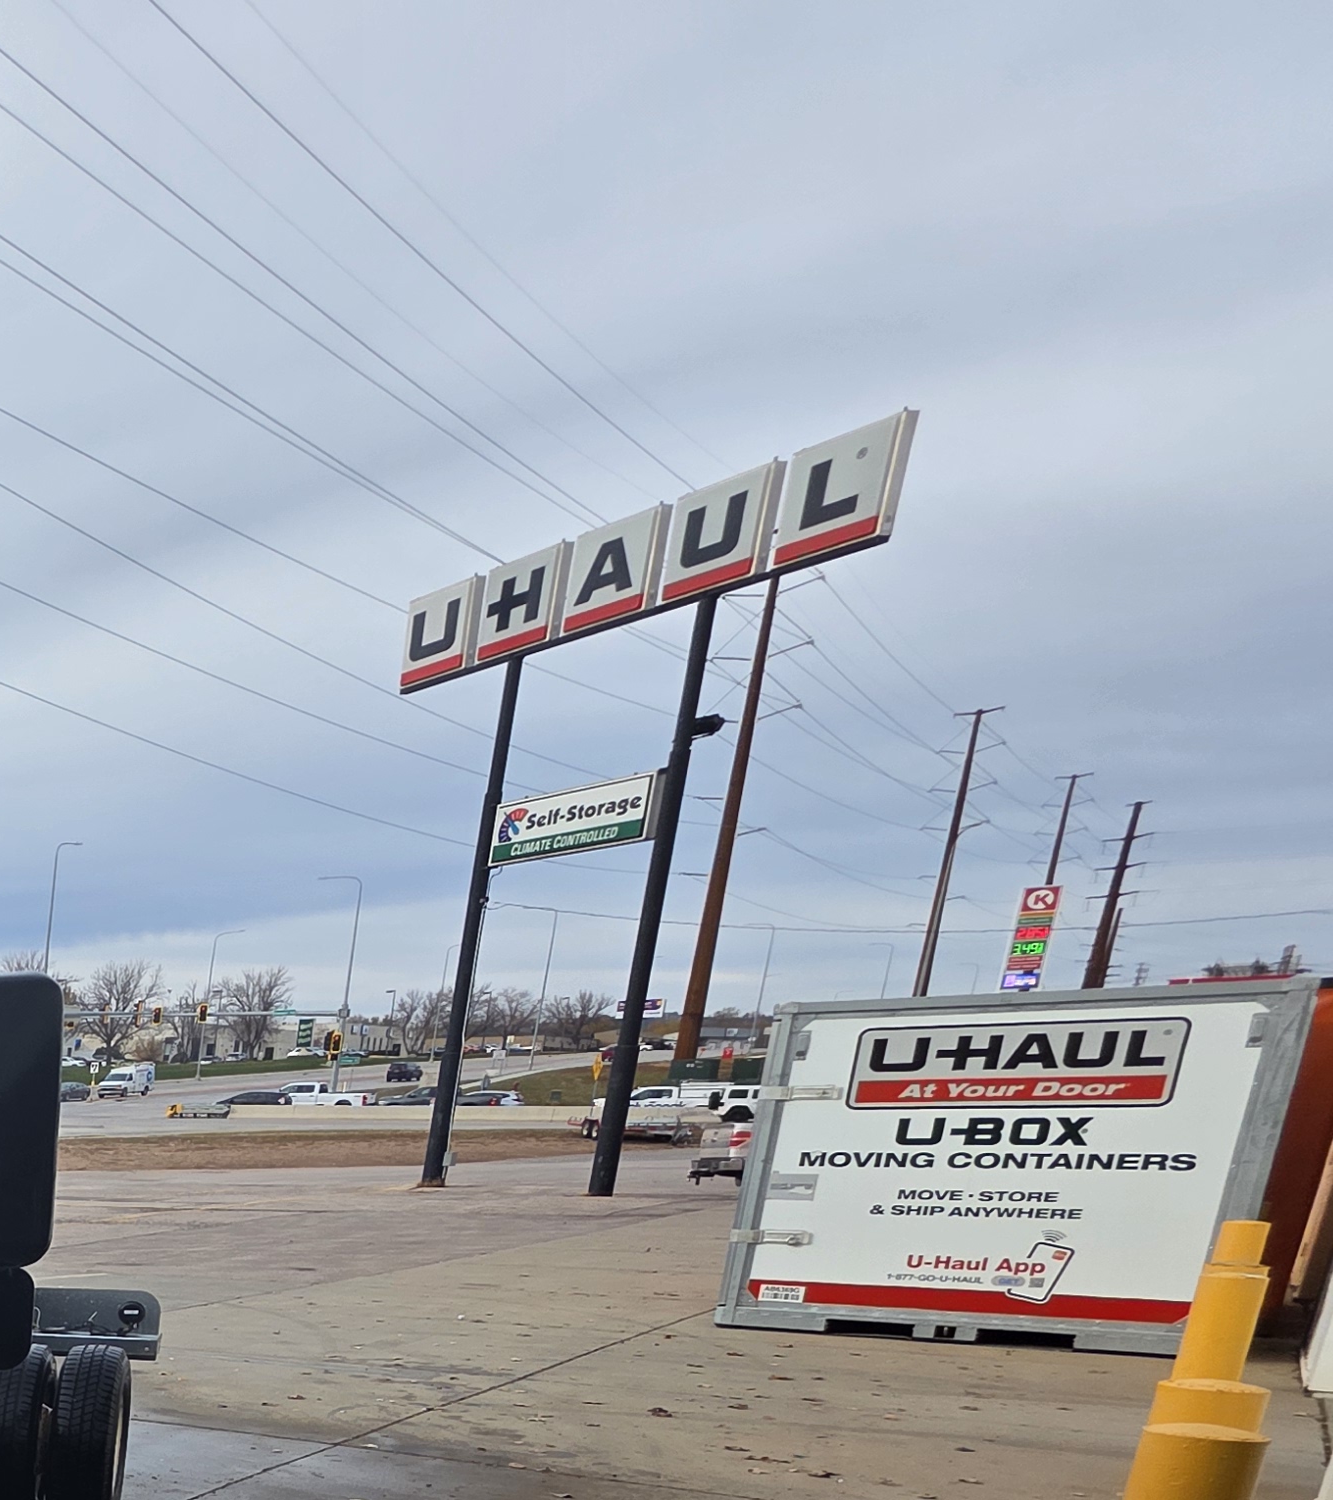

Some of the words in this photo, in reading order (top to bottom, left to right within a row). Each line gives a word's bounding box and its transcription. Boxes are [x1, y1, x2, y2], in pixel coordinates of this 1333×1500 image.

[525, 795, 643, 831] Self-Storage
[510, 839, 551, 857] CLIMATE
[553, 826, 619, 849] CONTROLLED
[868, 1029, 1166, 1072] U-HAUL
[897, 1083, 937, 1098] At
[947, 1083, 1025, 1098] Your
[1031, 1081, 1126, 1097] Door
[894, 1117, 1094, 1146] U-BOX
[798, 1151, 935, 1170] MOVING
[946, 1153, 1197, 1172] CONTAINERS
[897, 1188, 964, 1201] MOVE
[978, 1190, 1059, 1203] STORE
[869, 1204, 885, 1216] &
[890, 1204, 945, 1216] SHIP
[947, 1206, 1083, 1220] ANYWHERE
[906, 1254, 989, 1271] U-Haul
[994, 1258, 1046, 1276] App
